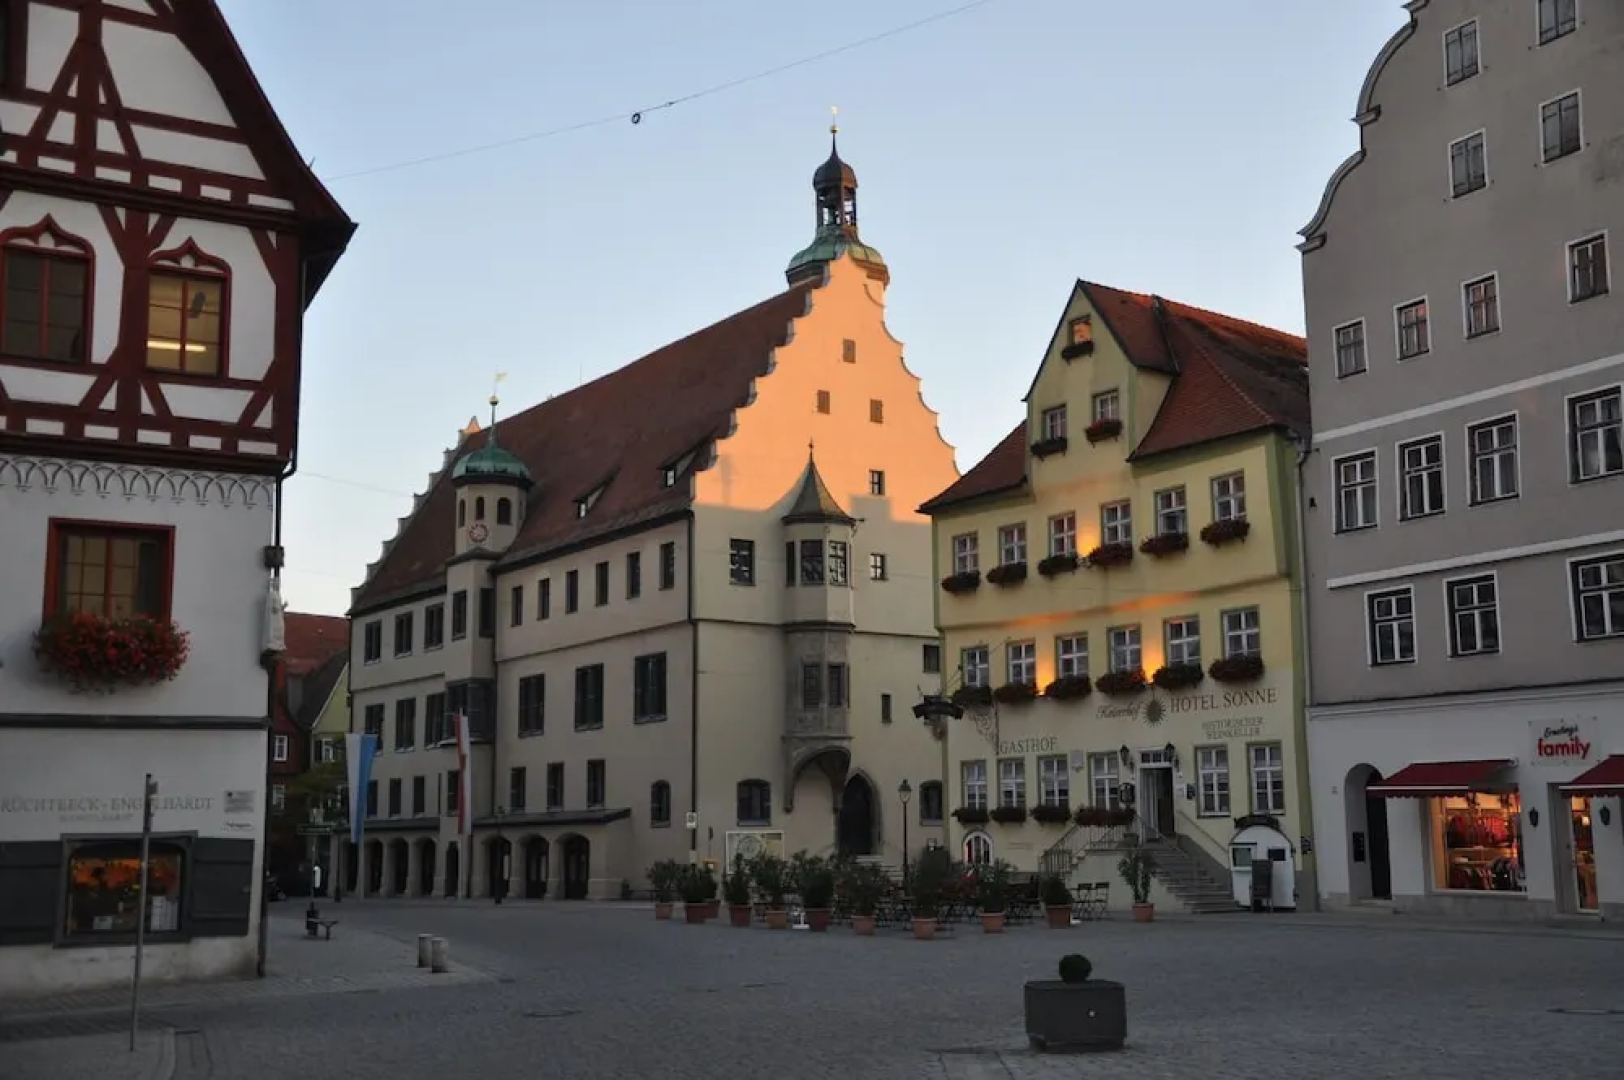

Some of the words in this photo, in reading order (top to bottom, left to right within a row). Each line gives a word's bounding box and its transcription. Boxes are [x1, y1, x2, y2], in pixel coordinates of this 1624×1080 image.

[1170, 694, 1218, 713] HOTEL
[1223, 688, 1277, 708] SONNE
[999, 737, 1057, 754] GASTHOF
[1537, 735, 1590, 760] family
[111, 796, 213, 811] ENGLHARDT
